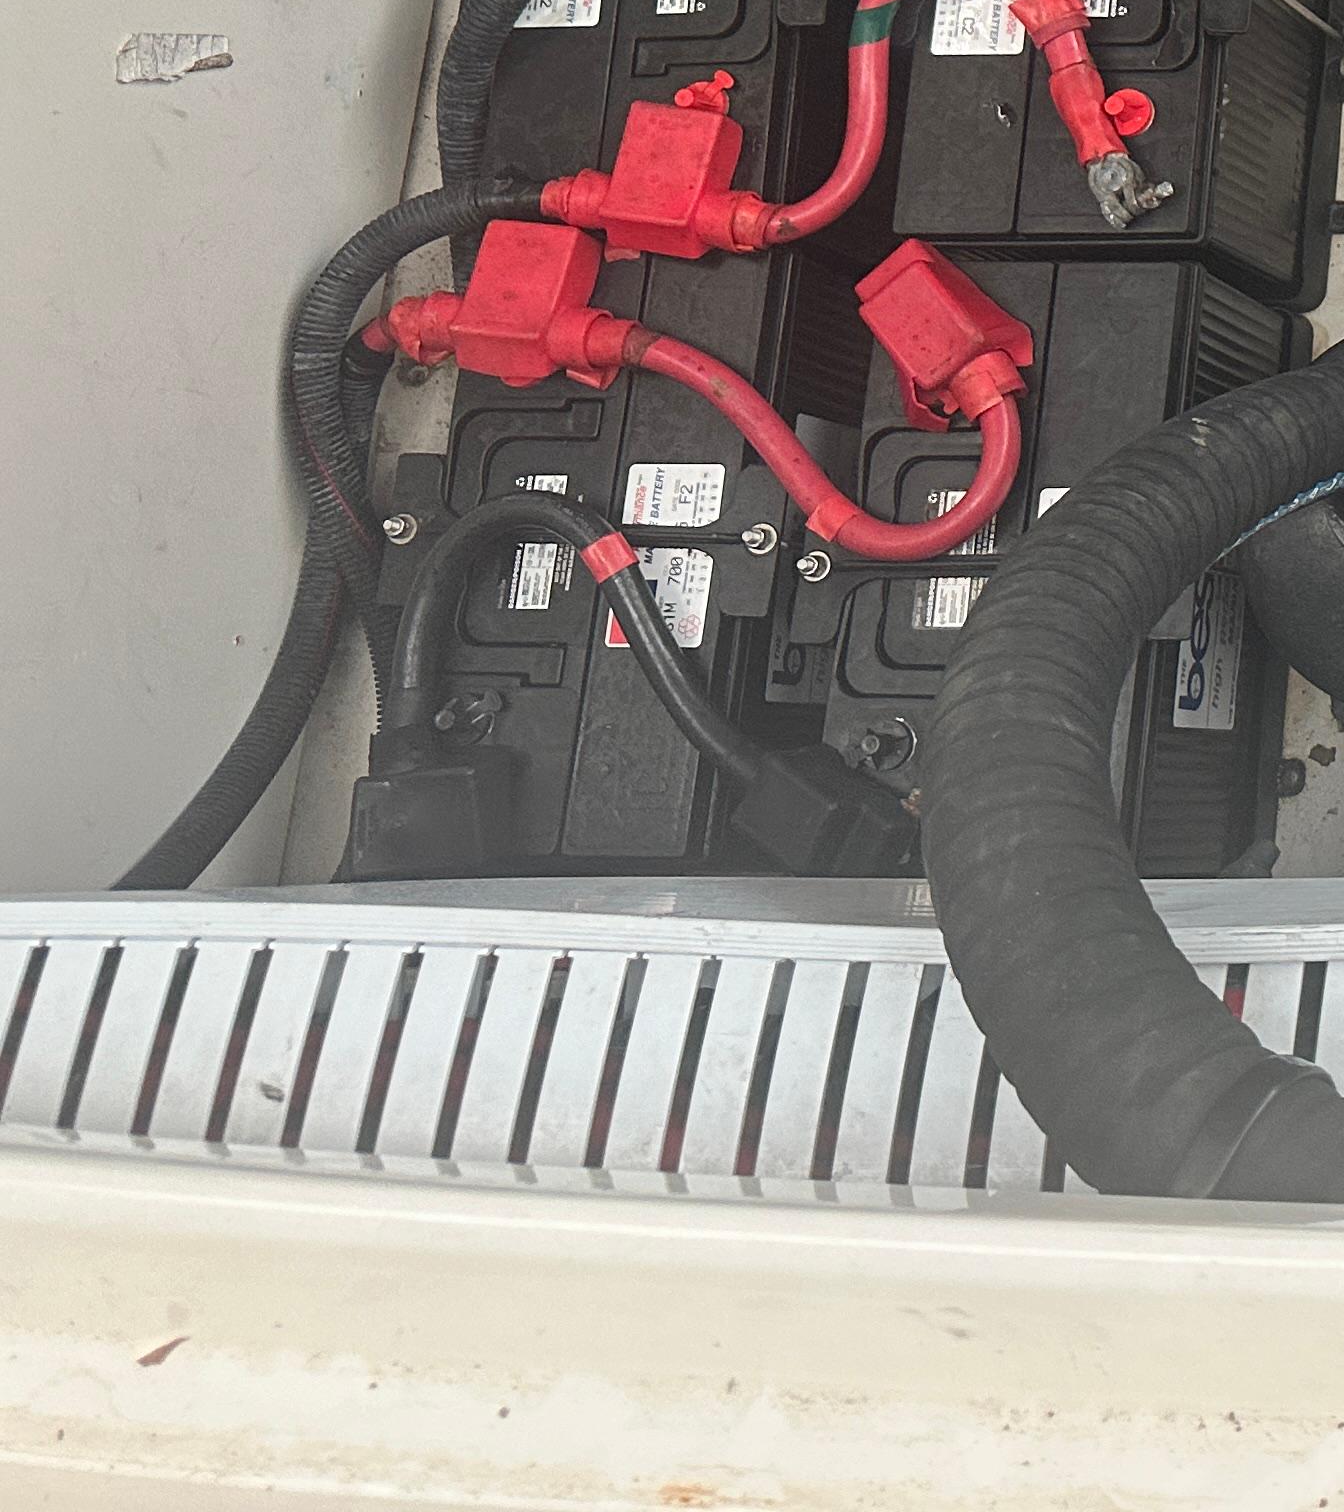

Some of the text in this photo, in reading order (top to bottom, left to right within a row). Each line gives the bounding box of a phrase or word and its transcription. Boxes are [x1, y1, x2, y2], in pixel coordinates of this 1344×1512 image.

[962, 17, 975, 35] C2
[988, 4, 1001, 51] BATTERY
[650, 467, 664, 519] BATTERY
[679, 485, 693, 504] F2
[667, 557, 683, 585] 700
